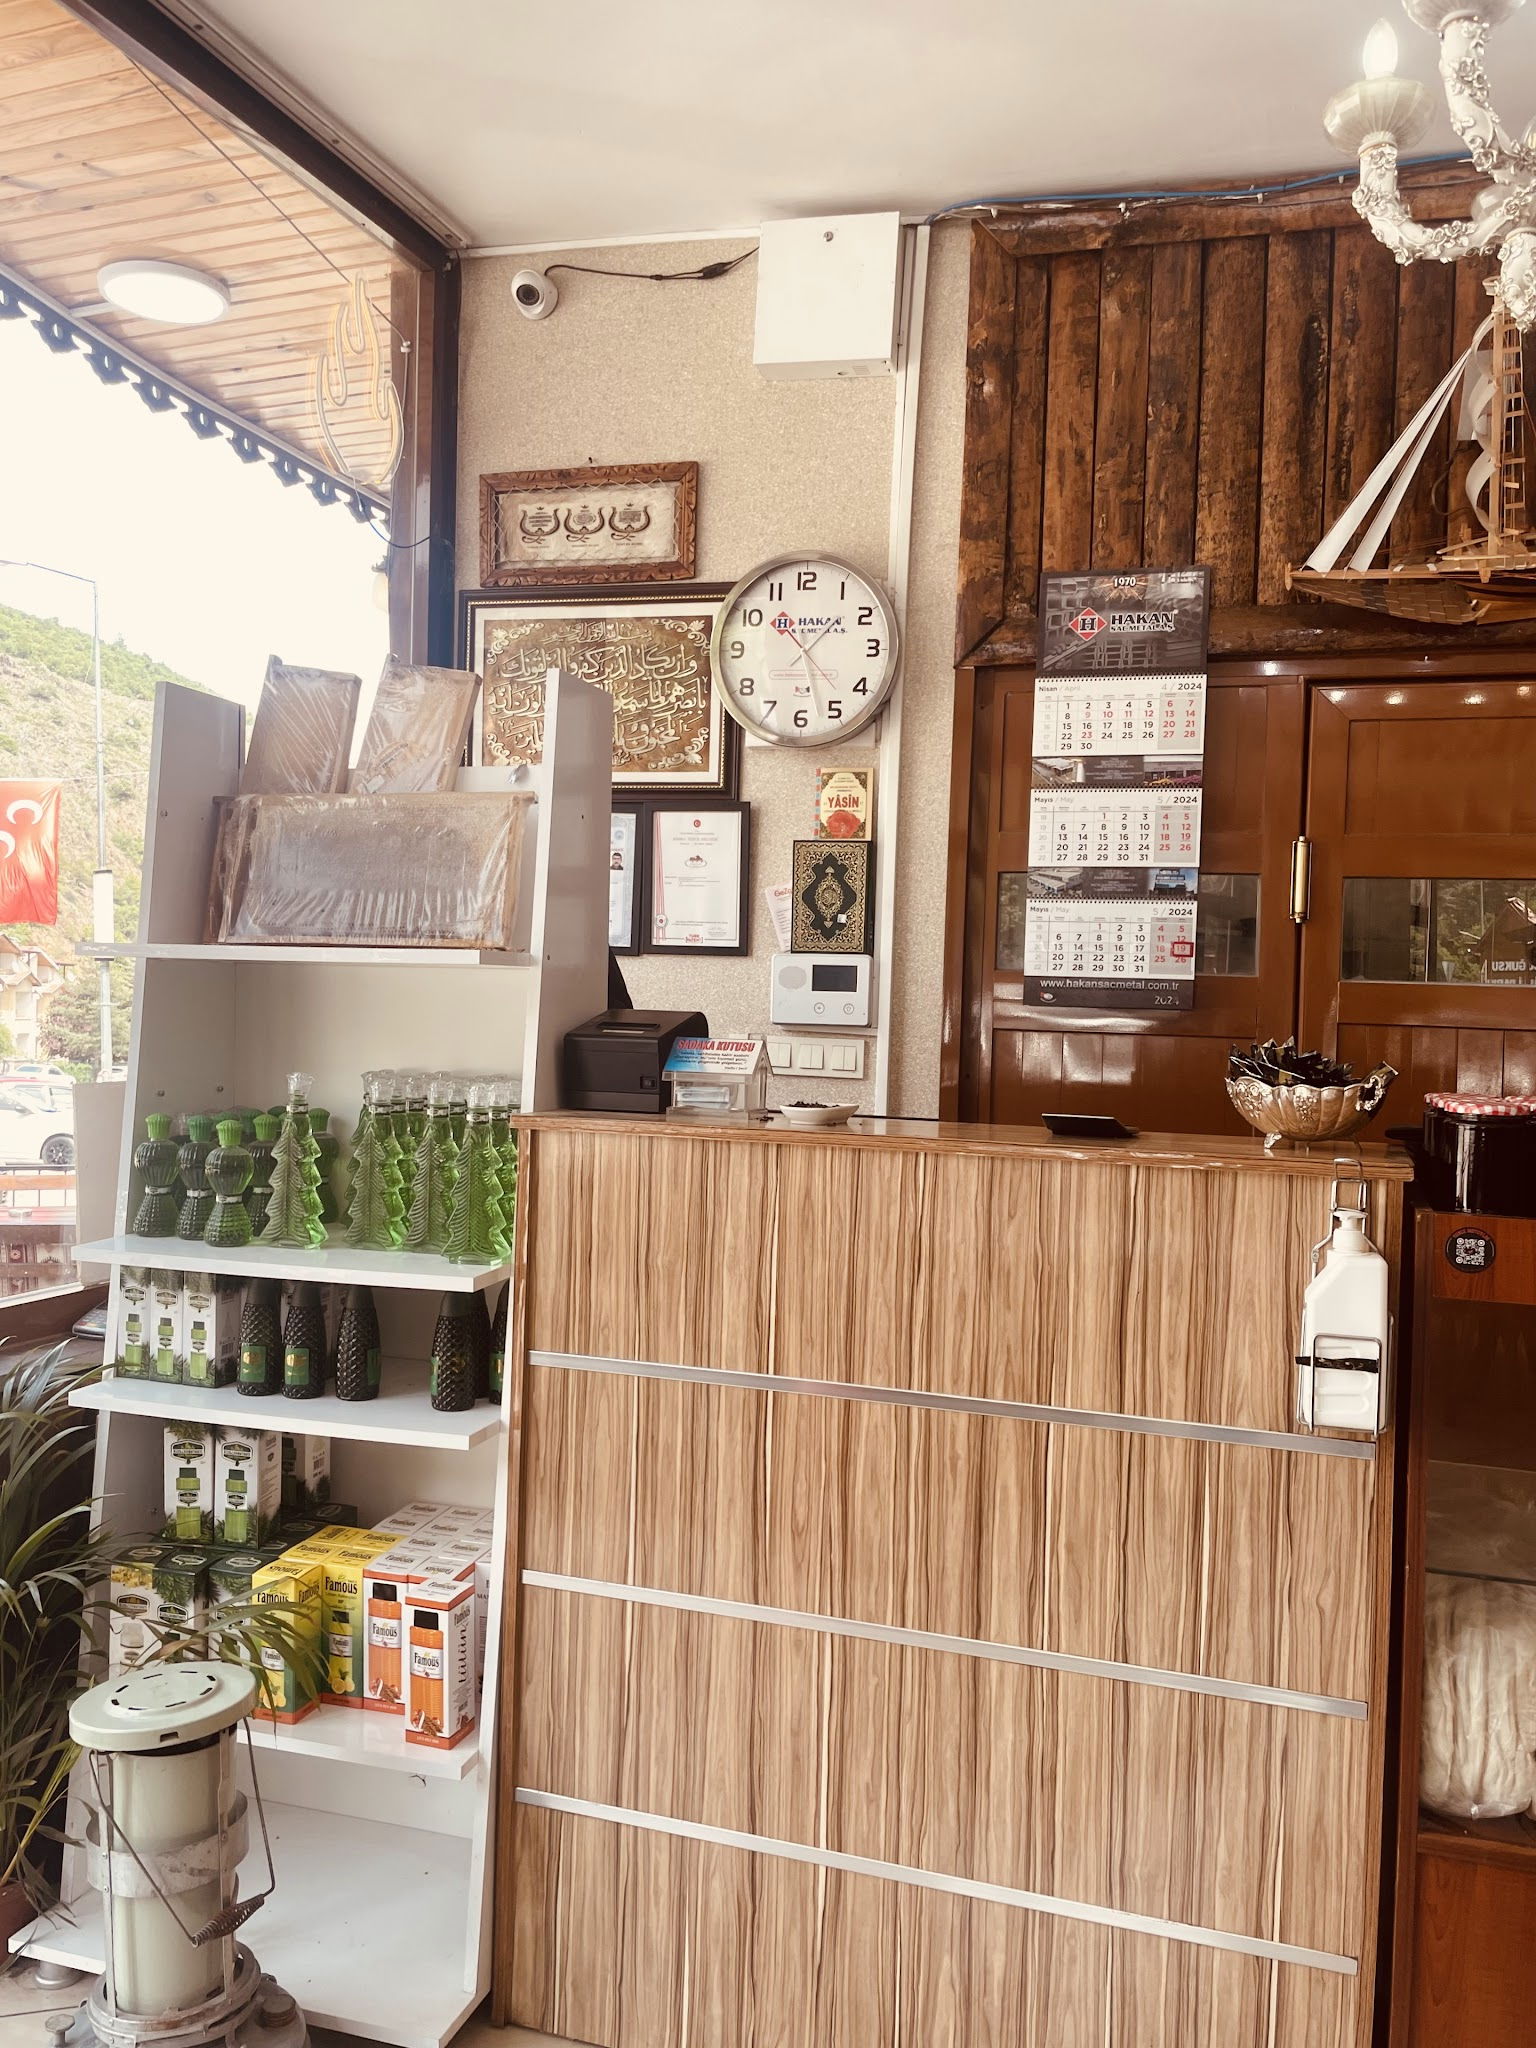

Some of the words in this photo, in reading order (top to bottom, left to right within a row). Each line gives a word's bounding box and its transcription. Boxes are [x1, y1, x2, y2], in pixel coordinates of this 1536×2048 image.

[797, 572, 817, 591] 12
[1113, 577, 1136, 587] 1970
[769, 583, 783, 601] 11
[840, 581, 845, 600] 1
[742, 608, 763, 627] 10
[798, 617, 841, 626] HAKAN
[857, 607, 873, 626] 2
[1111, 613, 1173, 625] HAKAN
[777, 618, 788, 629] H
[1080, 617, 1097, 631] H
[730, 640, 745, 659] 9
[866, 638, 880, 658] 3
[739, 677, 755, 696] 8
[853, 677, 868, 696] 4
[1177, 683, 1202, 691] 2024
[1188, 699, 1194, 707] 7
[762, 700, 777, 720] 7
[828, 700, 842, 719] 5
[1125, 710, 1132, 718] 11
[1165, 710, 1175, 718] 13
[793, 709, 808, 728] 6
[1083, 722, 1092, 730] 16
[1124, 721, 1133, 729] 18
[1163, 720, 1176, 728] 20
[1081, 731, 1092, 739] 23
[1184, 730, 1195, 738] 28
[1081, 742, 1092, 750] 30
[1173, 796, 1198, 804] 2024
[1121, 823, 1127, 831] 9
[1099, 833, 1108, 841] 15
[1140, 833, 1149, 841] 17
[1181, 833, 1191, 841] 19
[1168, 908, 1193, 916] 2024
[1179, 925, 1185, 933] 5
[1054, 943, 1063, 951] 13
[1156, 945, 1165, 953] 18
[1052, 953, 1064, 961] 20
[1154, 955, 1166, 963] 25
[1040, 979, 1179, 991] www.hakansacmetal.com.tr
[678, 1040, 715, 1051] SADAKA
[716, 1041, 755, 1052] KUTUSU
[325, 1576, 358, 1595] Famous
[372, 1622, 398, 1637] Famous
[414, 1652, 440, 1668] Famous
